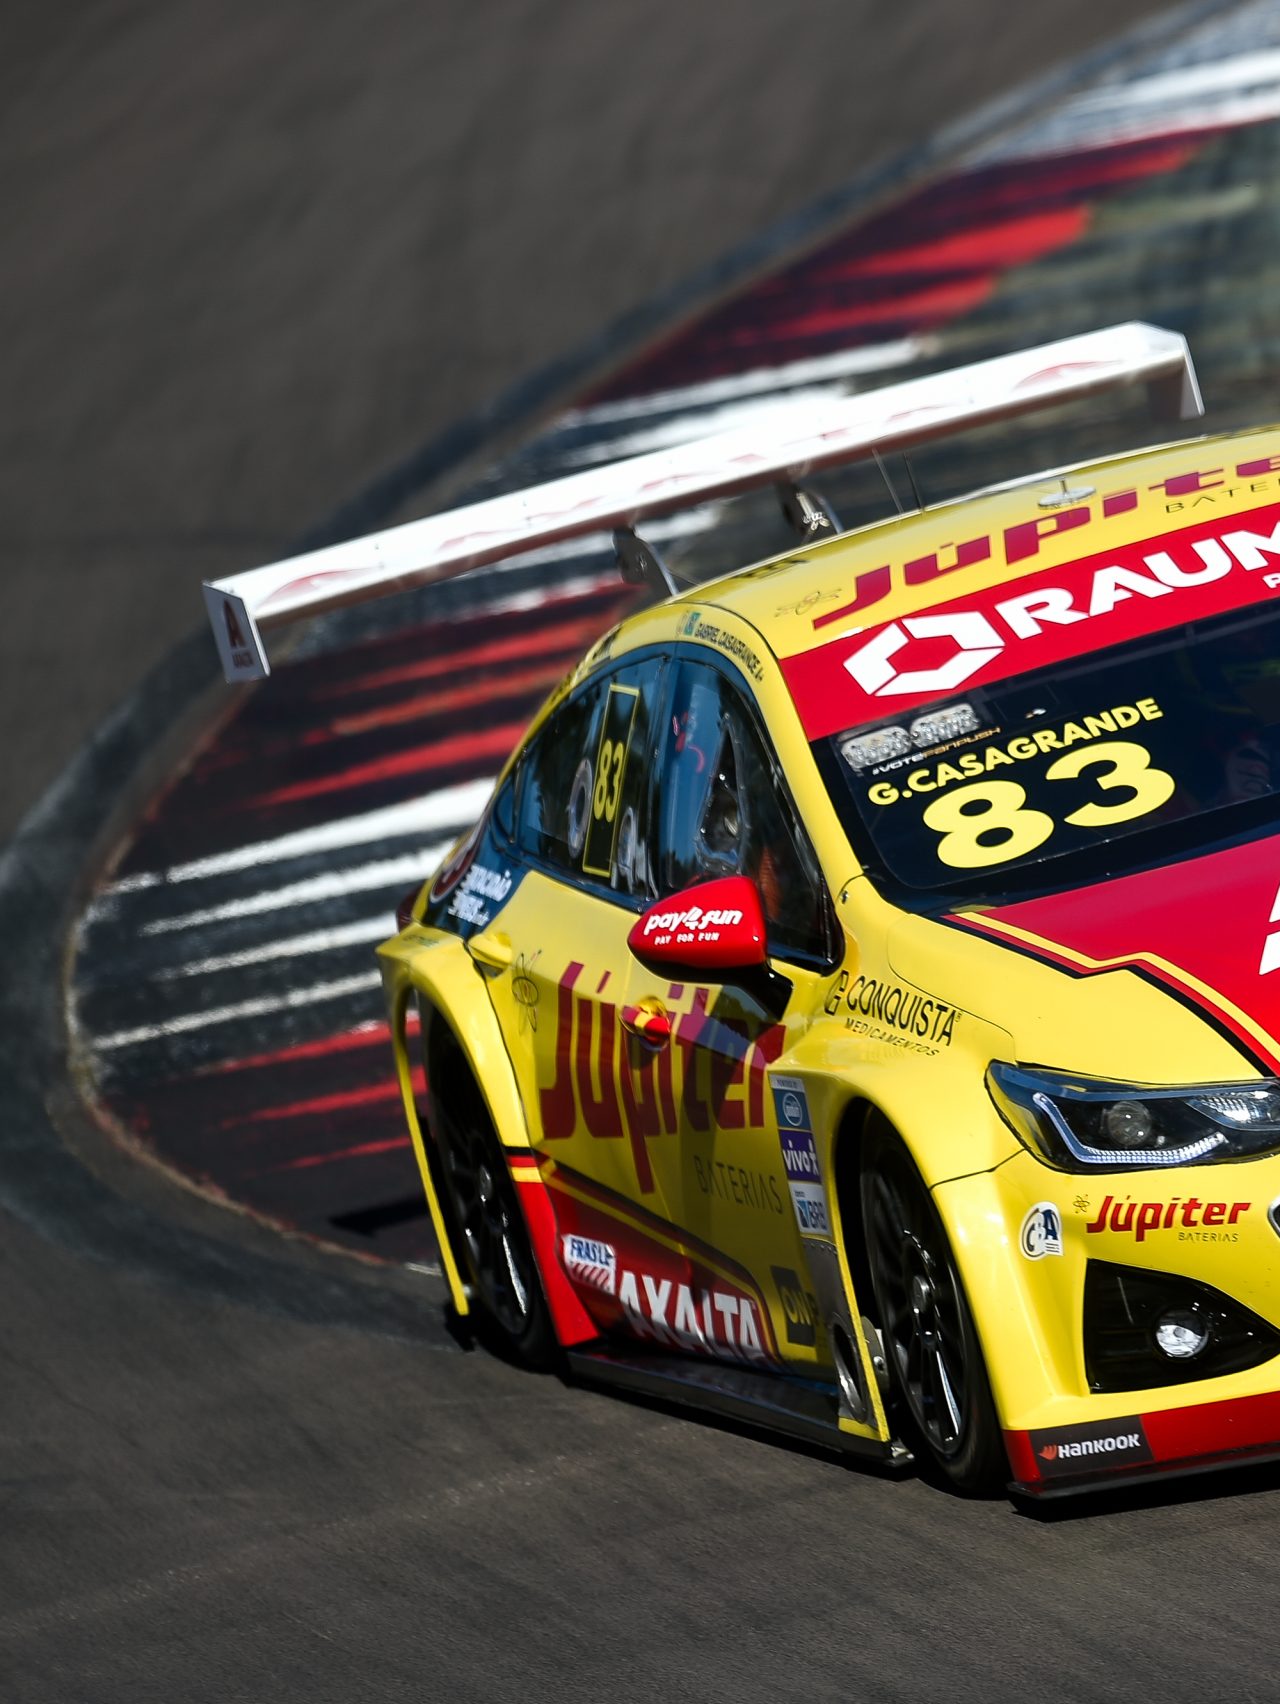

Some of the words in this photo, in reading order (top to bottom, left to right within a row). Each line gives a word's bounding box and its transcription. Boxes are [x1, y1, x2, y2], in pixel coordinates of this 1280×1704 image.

[867, 697, 1164, 806] G.CASAGRANDE
[593, 739, 625, 823] 83
[922, 741, 1176, 868] 83
[643, 906, 743, 935] pay4fun
[654, 935, 672, 945] PAY
[676, 933, 695, 943] FOR
[698, 932, 720, 942] FUN
[846, 975, 957, 1047] CONQUISTA
[846, 1017, 941, 1058] MEDICAMENTOS
[694, 1154, 783, 1215] BATERIAS
[1086, 1195, 1251, 1242] Júpiter
[1178, 1231, 1239, 1243] BATERIAS
